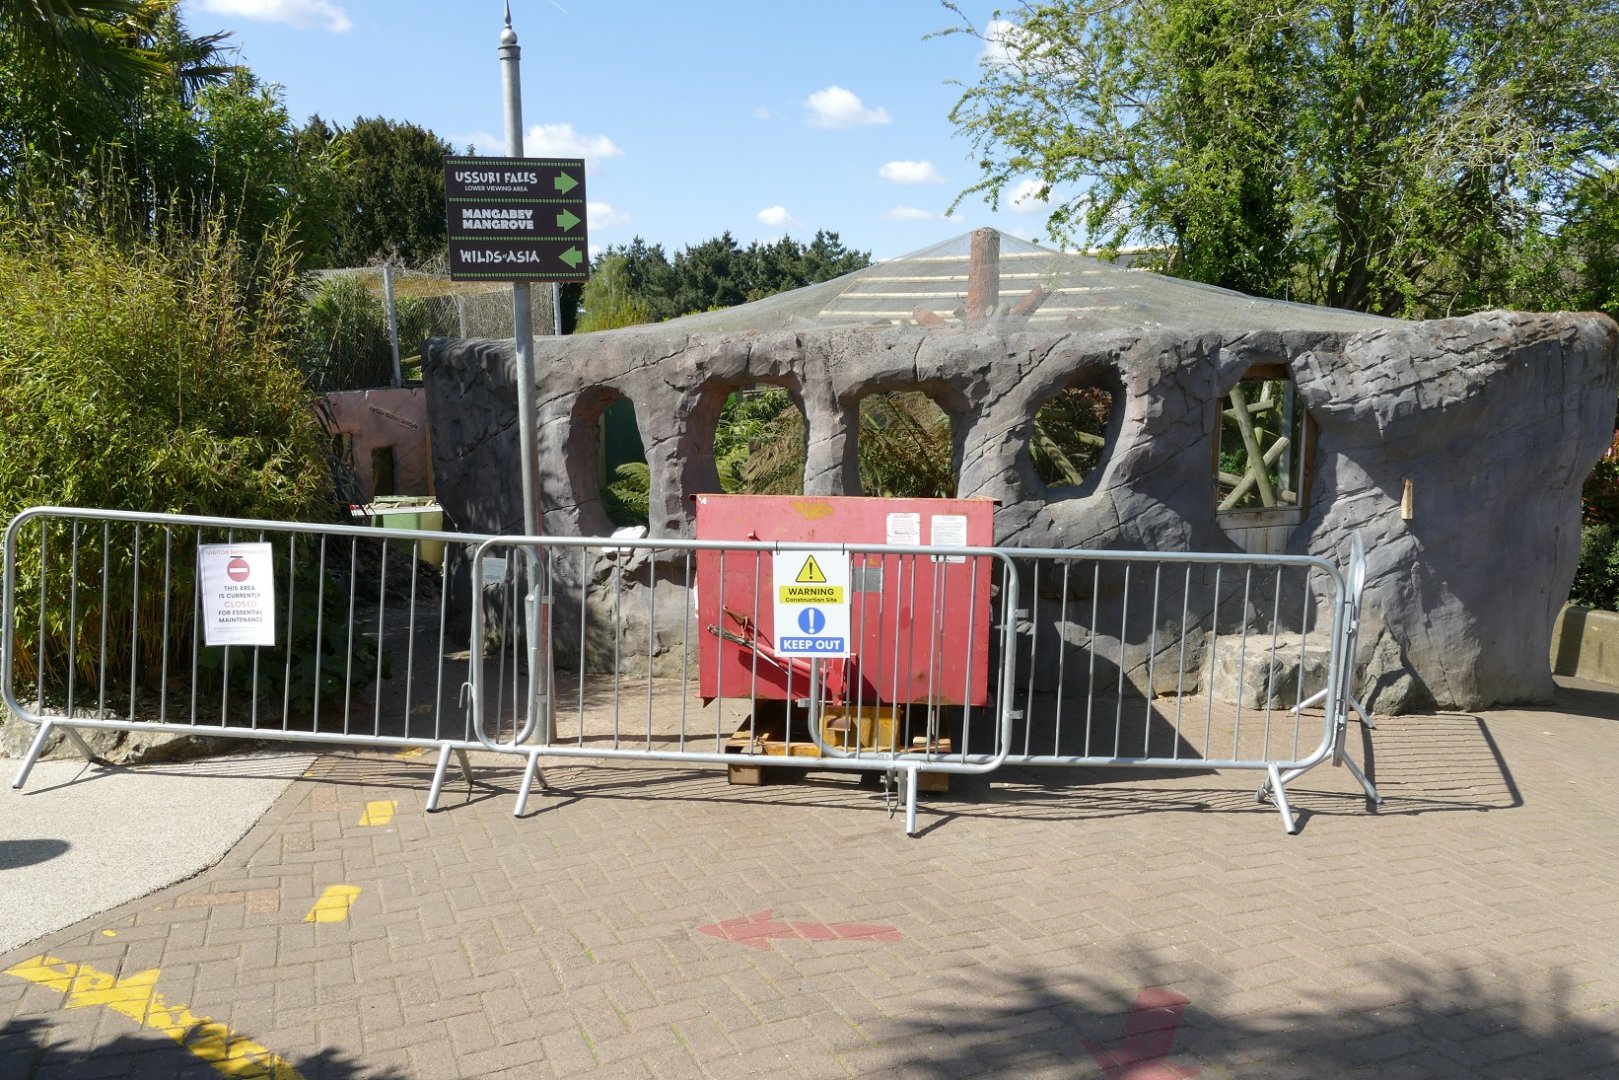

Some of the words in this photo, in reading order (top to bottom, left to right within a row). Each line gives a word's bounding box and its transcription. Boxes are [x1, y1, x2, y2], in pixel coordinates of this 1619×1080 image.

[455, 171, 500, 184] USSURI
[504, 172, 538, 184] FALLS
[462, 209, 533, 219] MANGABEY
[462, 220, 534, 229] MANGROVE
[460, 249, 502, 262] WILDS
[506, 250, 540, 263] ASIA
[784, 640, 813, 649] KEEP
[816, 640, 840, 649] OUT
